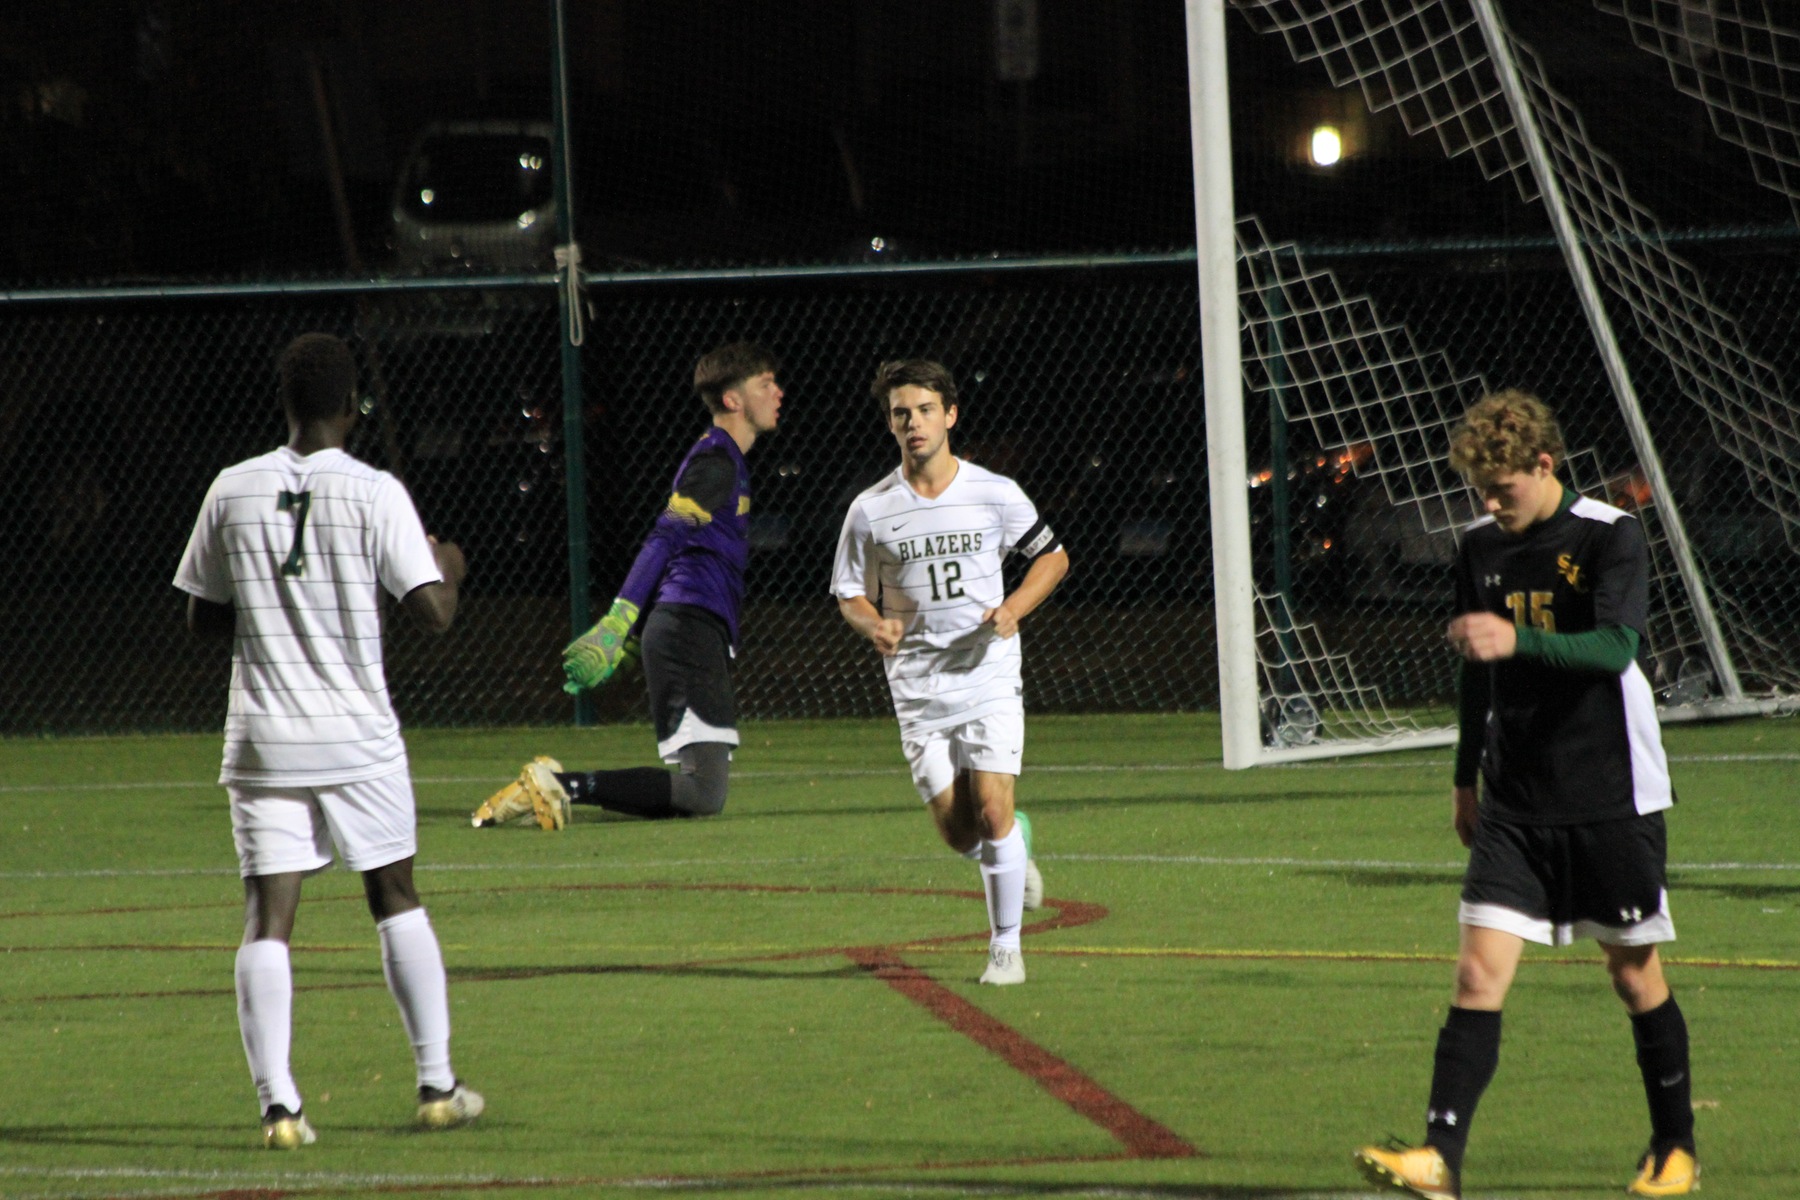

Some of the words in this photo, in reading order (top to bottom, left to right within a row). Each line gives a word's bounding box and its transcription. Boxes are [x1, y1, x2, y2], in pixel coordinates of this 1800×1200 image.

[276, 490, 312, 577] 7
[898, 532, 983, 562] BLAZERS
[928, 561, 965, 602] 12
